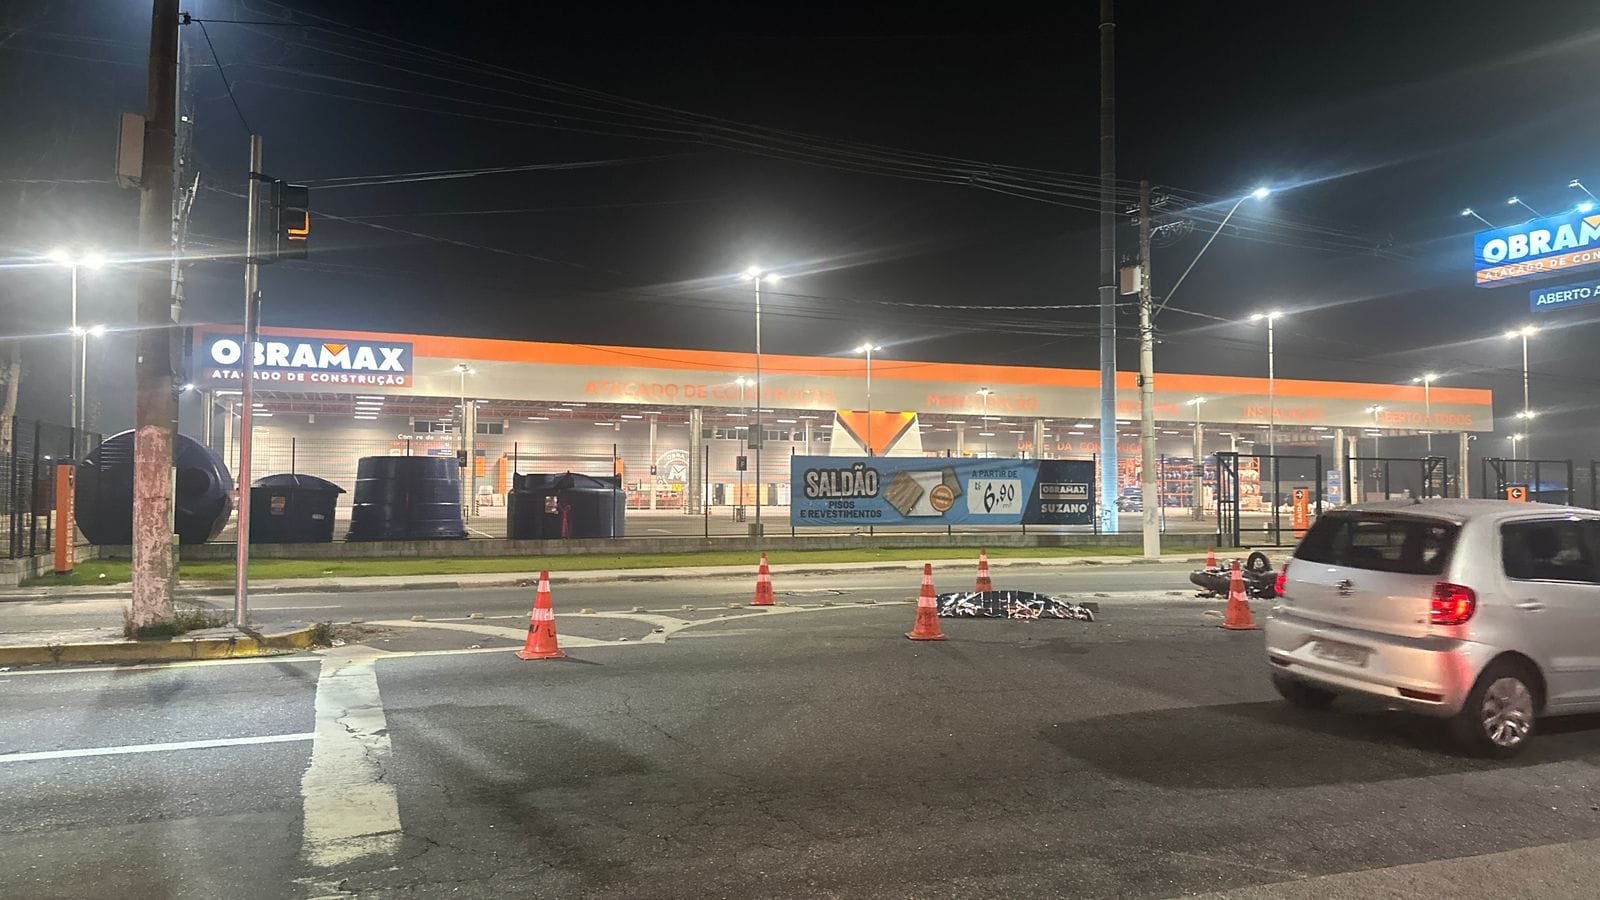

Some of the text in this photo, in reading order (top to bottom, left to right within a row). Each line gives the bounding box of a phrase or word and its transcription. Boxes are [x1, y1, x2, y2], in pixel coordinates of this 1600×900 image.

[1550, 258, 1566, 268] DE
[1536, 288, 1590, 305] ABERTO
[211, 339, 405, 372] OBRAMAX
[212, 370, 405, 386] ATAADO DE CONSTRUÇÃO
[584, 379, 679, 398] ATACADO
[684, 385, 708, 399] DE
[1057, 441, 1073, 451] DA
[806, 465, 877, 497] SALDÃO
[1043, 485, 1086, 493] OBRAMAX
[984, 482, 1014, 513] 6,90
[828, 501, 855, 509] PISOS
[1041, 503, 1088, 513] SUZANO
[801, 510, 882, 518] E REVESTIMENTOS
